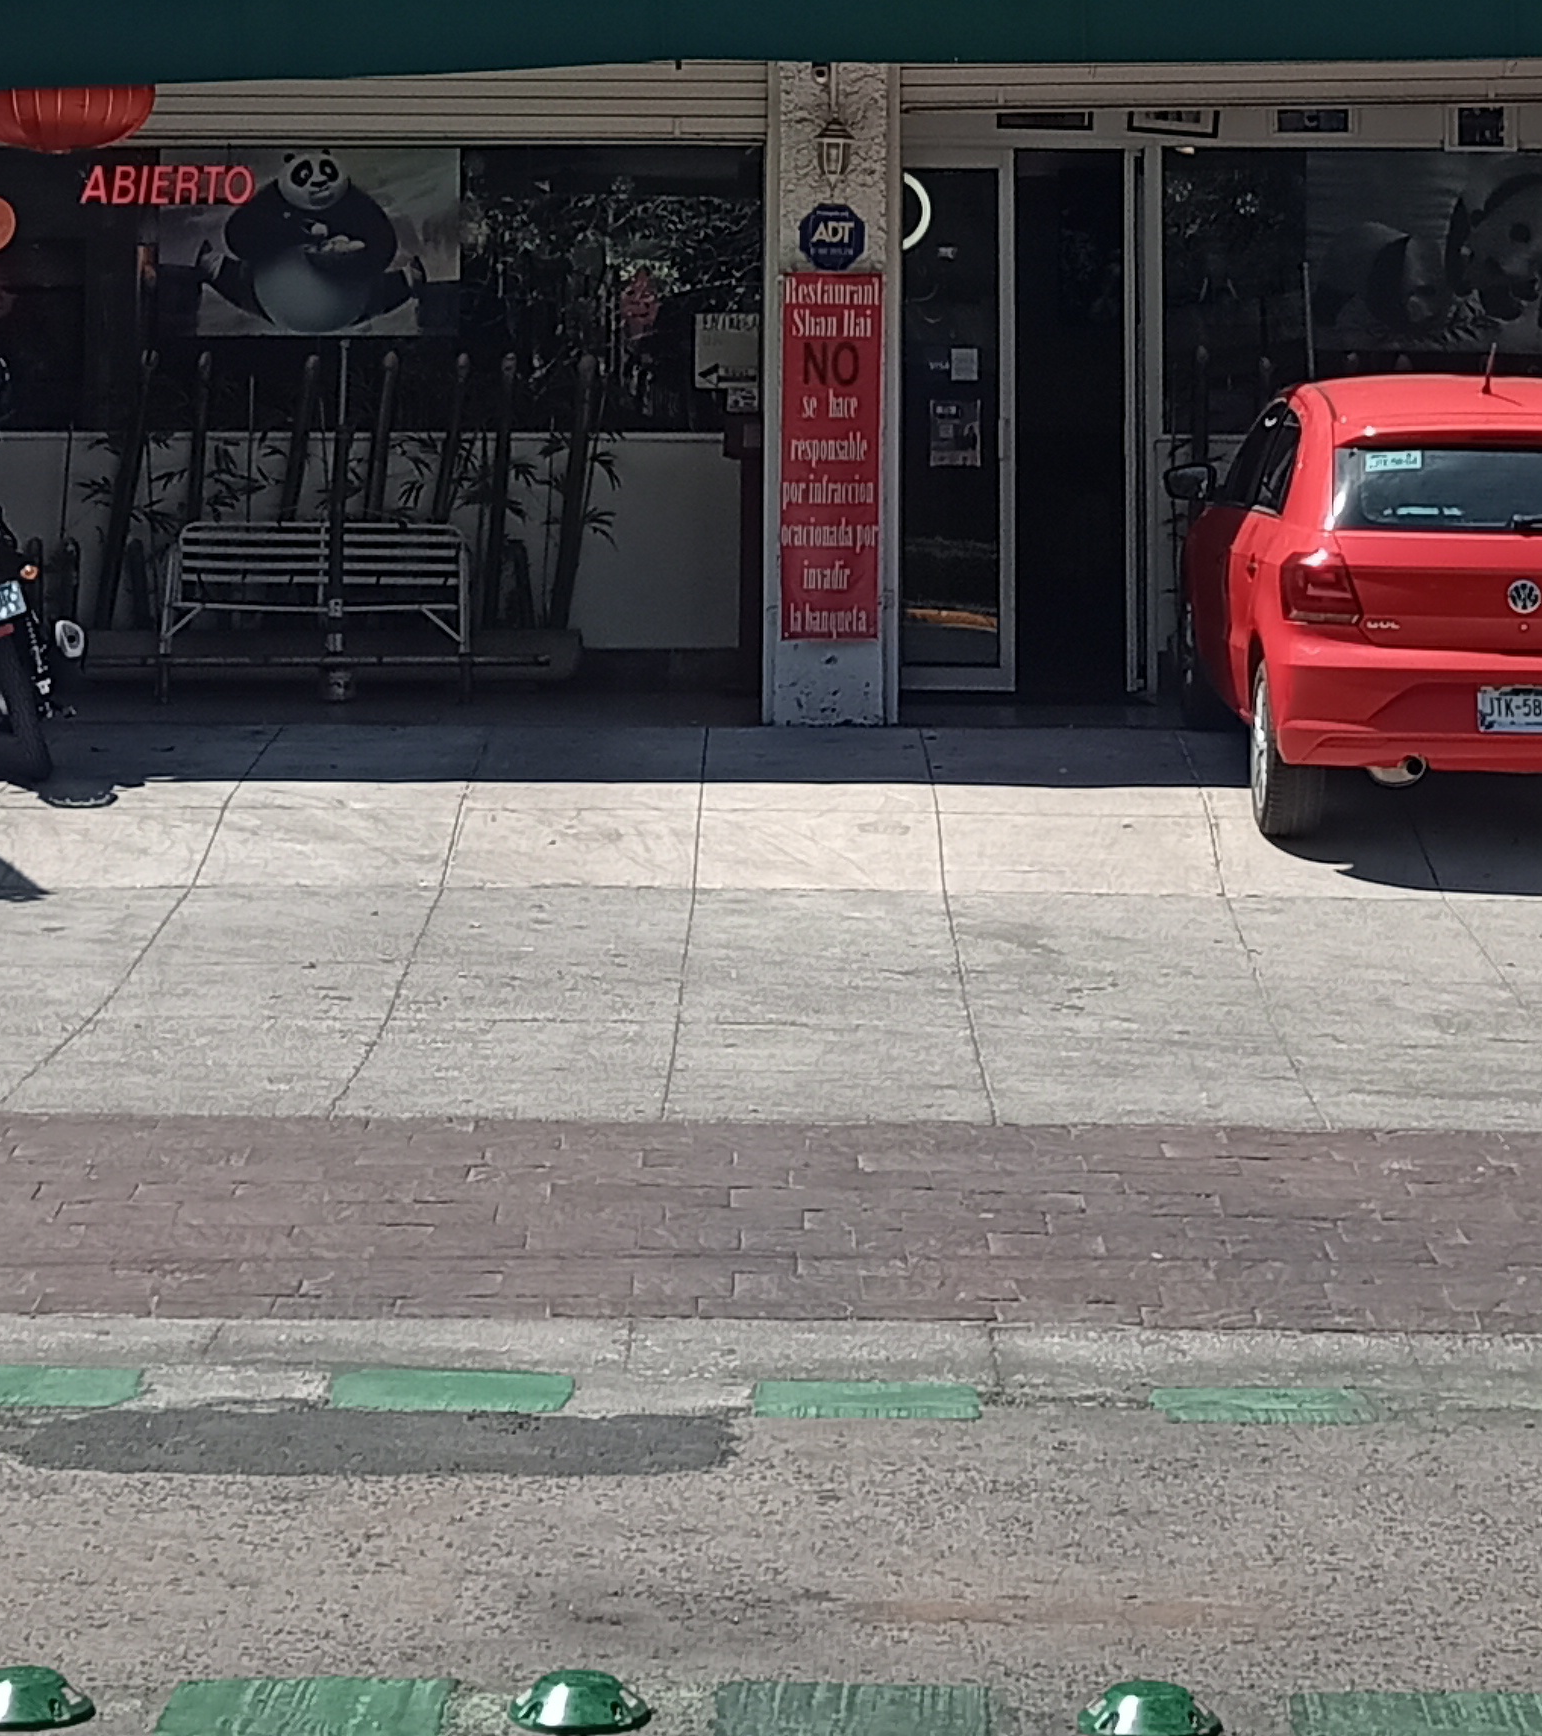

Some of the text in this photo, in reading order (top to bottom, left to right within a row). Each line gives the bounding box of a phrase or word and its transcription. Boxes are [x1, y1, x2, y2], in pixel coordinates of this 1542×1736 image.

[79, 165, 256, 205] ABIERTO
[811, 221, 855, 244] ADT
[785, 276, 880, 306] Restaurant
[791, 308, 837, 338] Shan
[843, 308, 873, 338] Hai
[802, 340, 859, 387] NO
[802, 388, 858, 419] se hace
[790, 431, 868, 468] responsable
[782, 480, 806, 510] por
[856, 524, 879, 554] por
[803, 559, 851, 590] invadir
[790, 602, 867, 640] la banqueta
